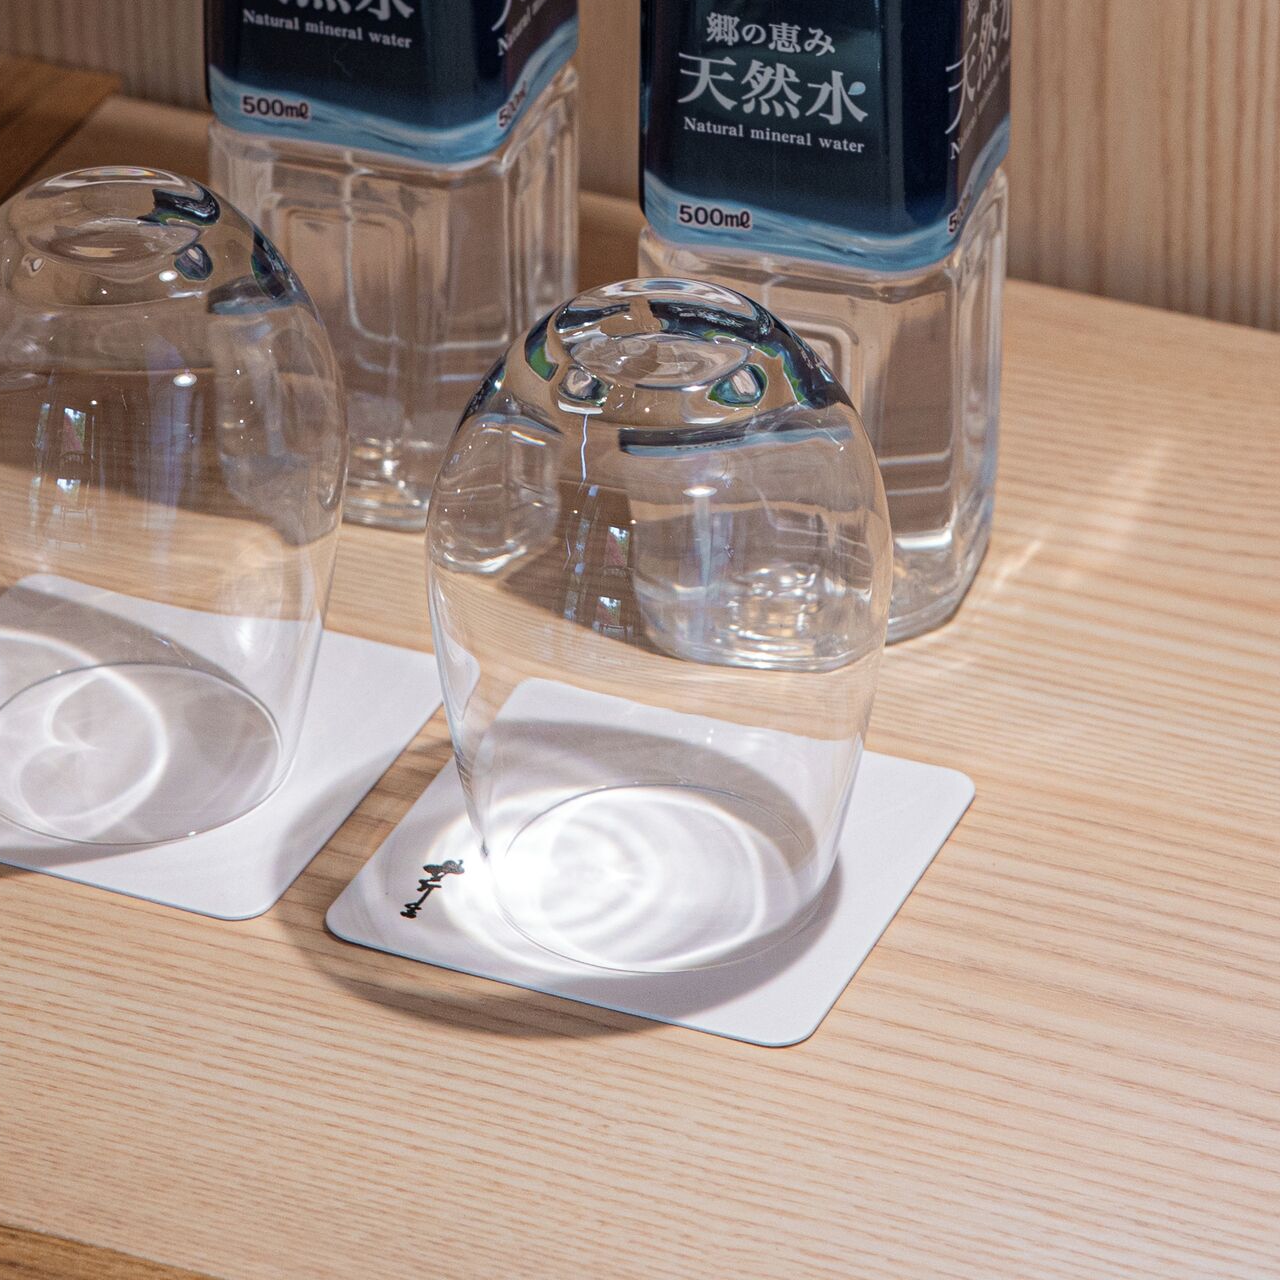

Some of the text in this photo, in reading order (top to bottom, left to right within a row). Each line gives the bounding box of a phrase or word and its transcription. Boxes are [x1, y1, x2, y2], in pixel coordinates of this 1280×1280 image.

[243, 8, 412, 49] Natural mineral water
[706, 12, 836, 57] 郷の恵み
[677, 52, 868, 125] 天然水
[683, 116, 865, 154] Natural mineral water
